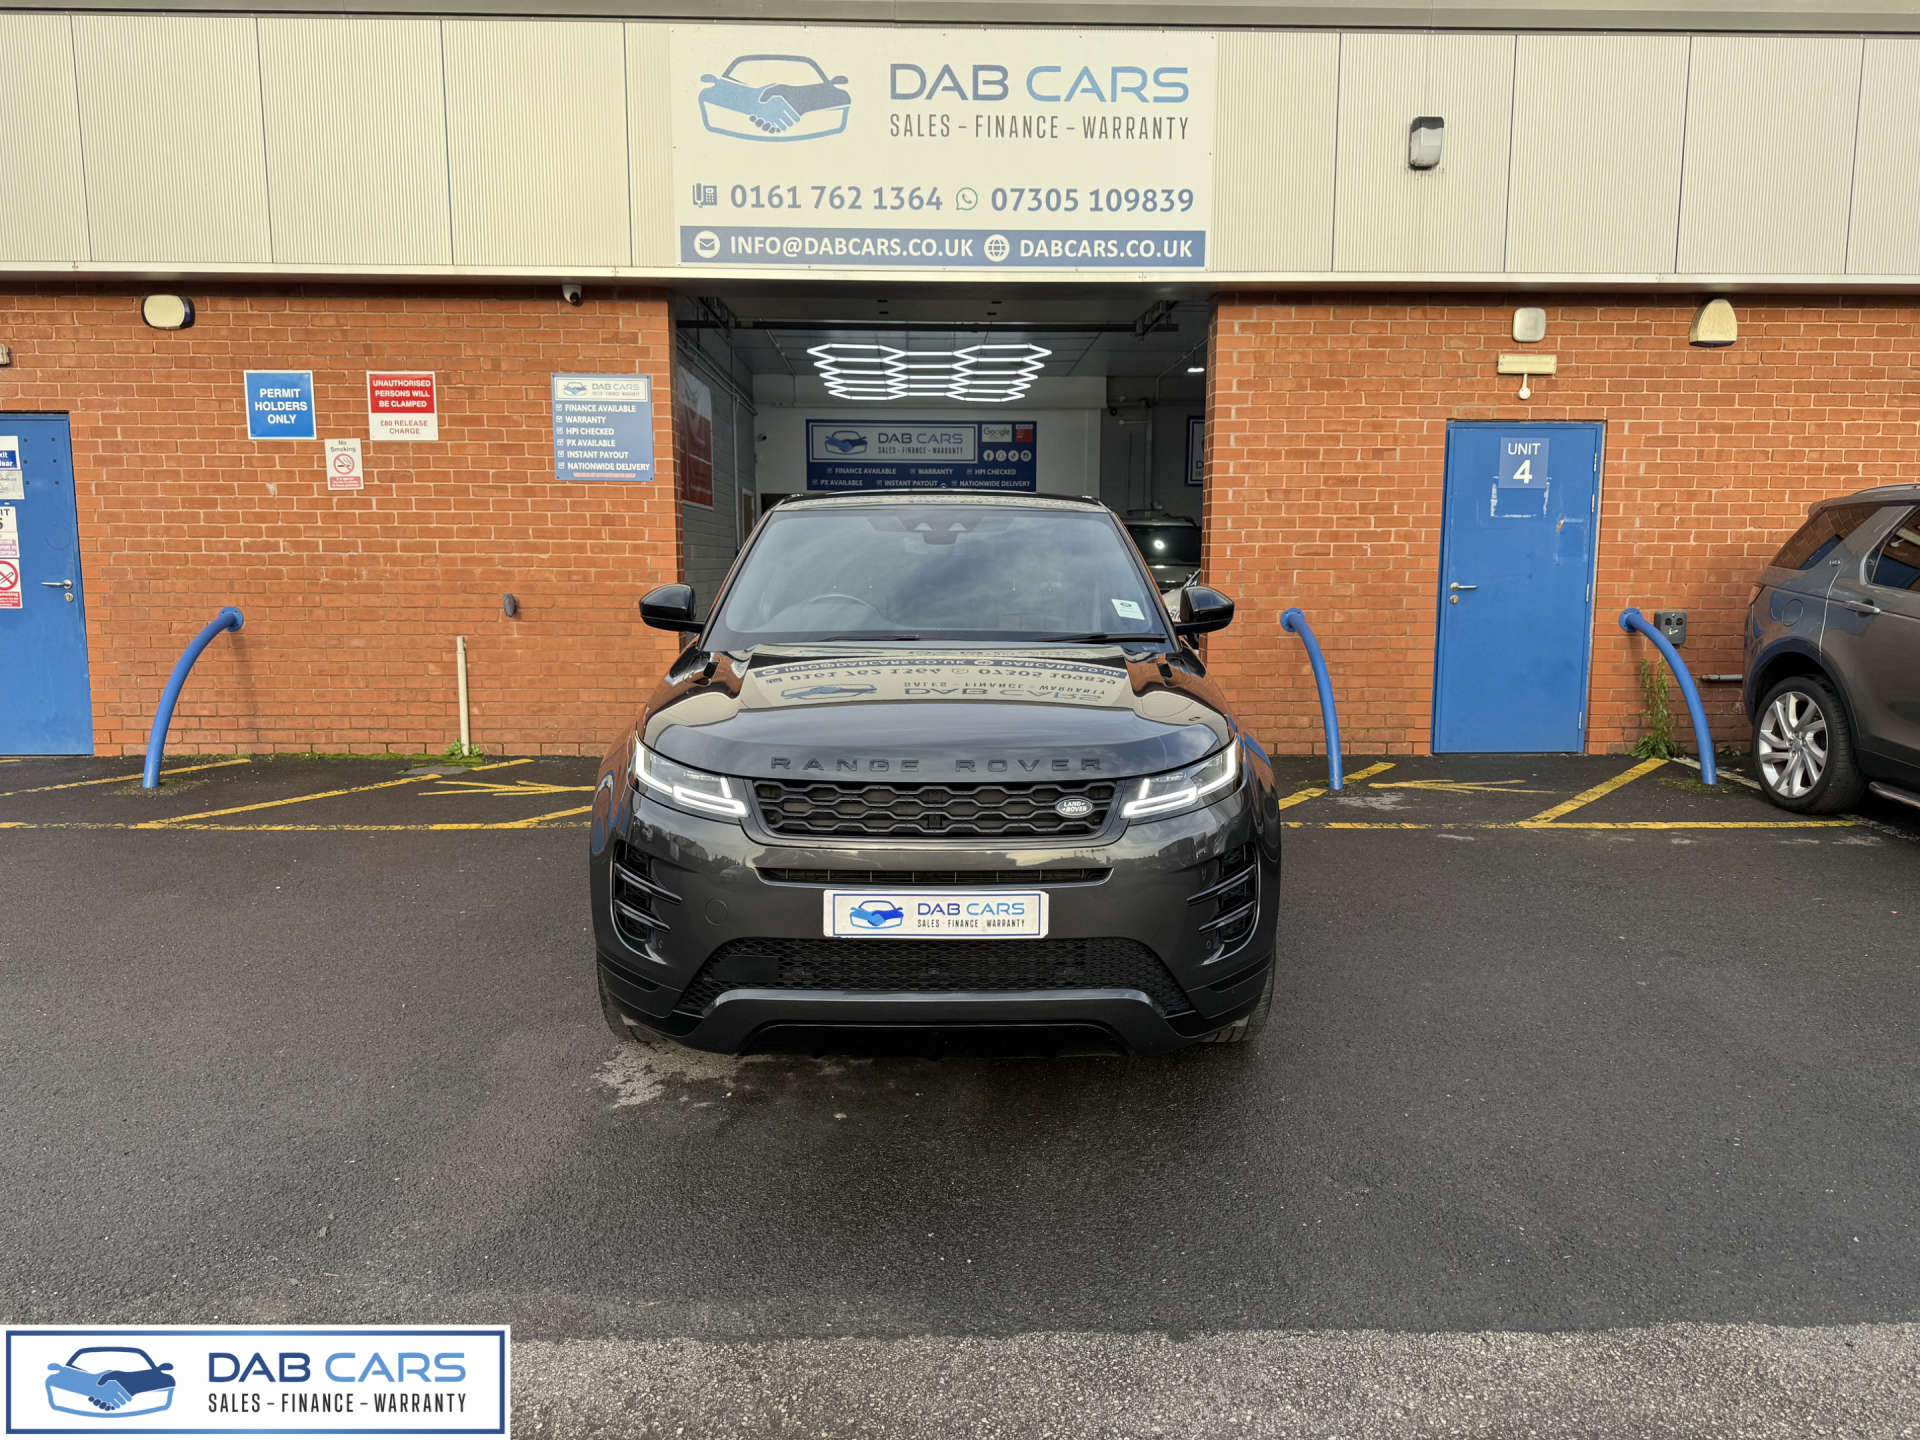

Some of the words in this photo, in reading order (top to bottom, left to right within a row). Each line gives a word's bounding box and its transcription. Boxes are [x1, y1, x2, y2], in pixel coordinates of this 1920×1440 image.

[889, 63, 1009, 102] DAB
[1025, 65, 1190, 104] CARS
[889, 113, 951, 138] SALES
[975, 114, 1059, 139] FINANCE
[1082, 116, 1189, 141] WARRANTY
[731, 185, 801, 210] 0161
[811, 185, 863, 210] 762
[873, 186, 943, 211] 1364
[990, 187, 1079, 212] 07305
[1089, 188, 1194, 213] 109839
[730, 235, 974, 259] INFO@DABCARS.CO.UK
[1019, 237, 1193, 259] DABCARS.CO.UK
[372, 379, 431, 387] UNAUTHORISED
[259, 388, 301, 398] PERMIT
[374, 389, 410, 398] PERSONS
[411, 389, 431, 398] WILL
[255, 401, 308, 411] HOLDERS
[379, 400, 390, 408] BE
[391, 400, 428, 408] CLAMPED
[565, 404, 596, 412] FINANCE
[598, 404, 637, 413] AVAILABLE
[267, 414, 297, 424] ONLY
[565, 416, 606, 424] WARRANTY
[389, 427, 421, 435] CHARGE
[566, 427, 579, 435] HPI
[878, 432, 913, 444] DAB
[916, 433, 963, 445] CARS
[1507, 442, 1541, 456] UNIT
[567, 451, 598, 459] INSTANT
[600, 451, 629, 459] PAYOUT
[567, 462, 615, 471] NATIONWIDE
[616, 463, 650, 471] DELIVERY
[835, 467, 862, 475] FINANCE
[863, 467, 897, 475] AVAILABLE
[1512, 459, 1533, 484] 4
[771, 757, 919, 773] RANGE
[955, 757, 1102, 773] ROVER
[917, 902, 961, 916] DAB
[966, 902, 1025, 916] CARS
[917, 919, 940, 928] SALES
[948, 919, 978, 928] FINANCE
[986, 919, 1025, 928] WARRANTY
